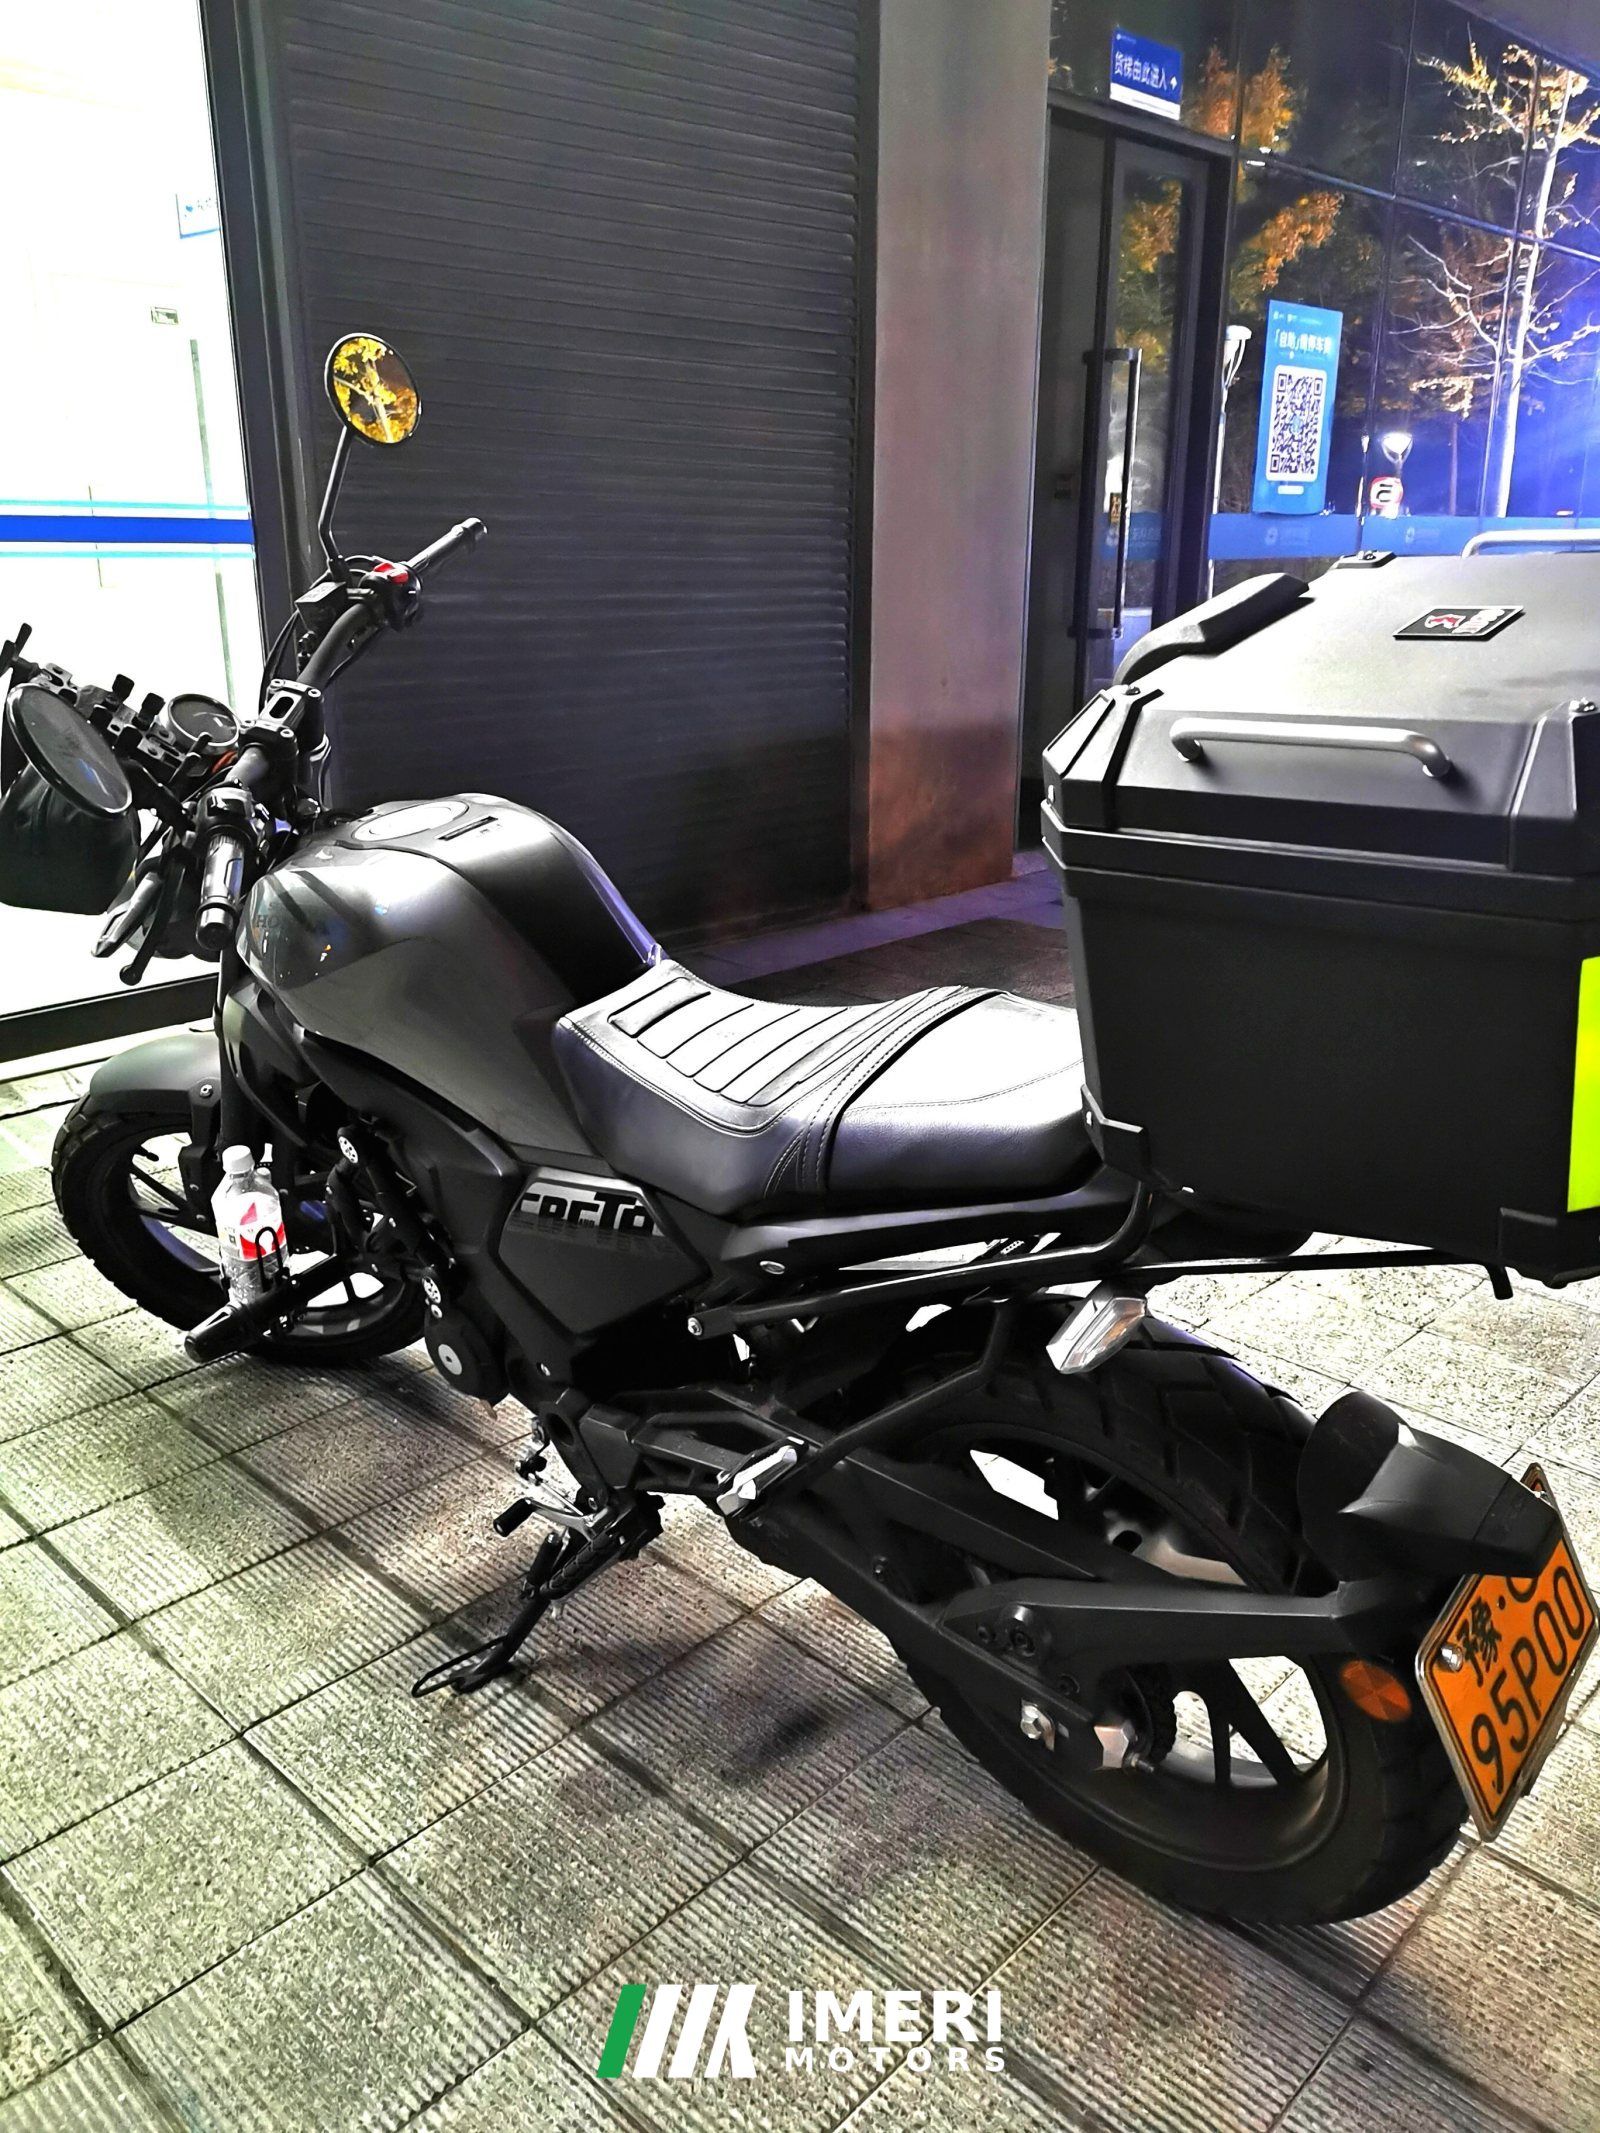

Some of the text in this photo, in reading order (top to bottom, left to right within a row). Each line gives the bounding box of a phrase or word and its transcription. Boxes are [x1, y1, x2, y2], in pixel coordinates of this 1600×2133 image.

[1115, 51, 1168, 91] 货梯由此进入
[1471, 1565, 1586, 1796] 95P00
